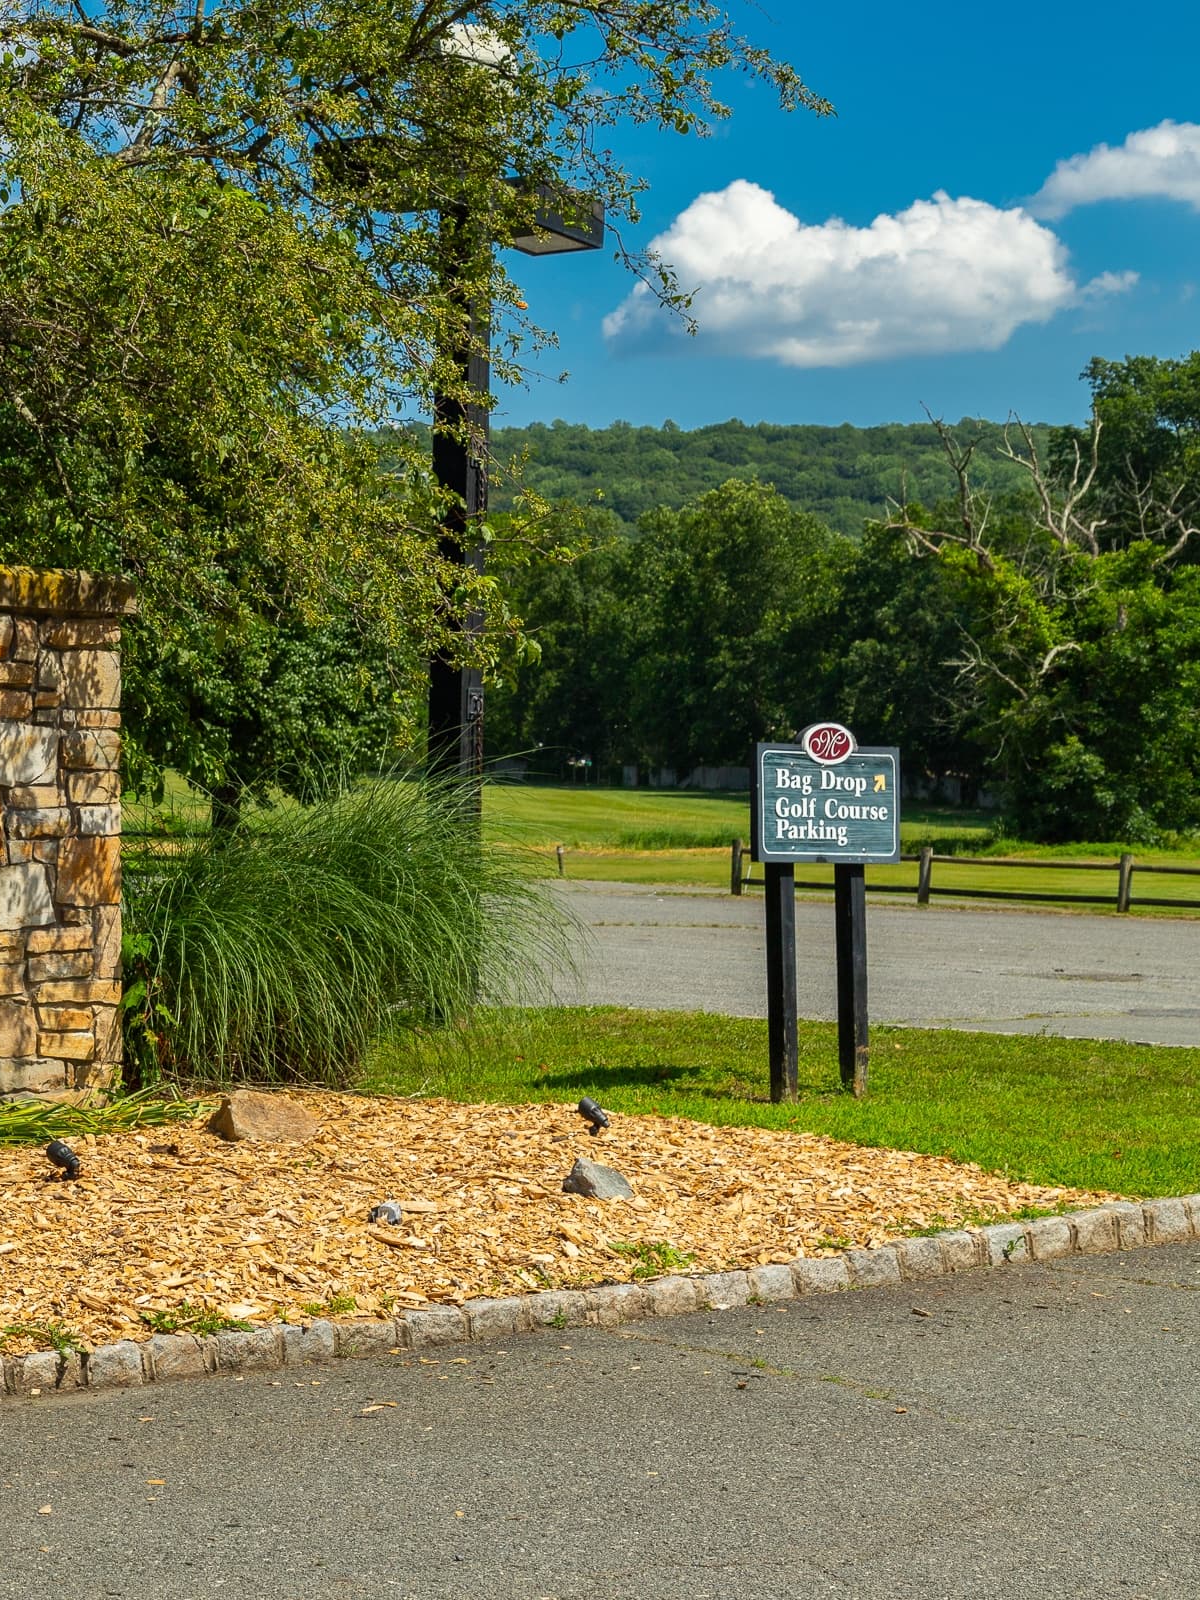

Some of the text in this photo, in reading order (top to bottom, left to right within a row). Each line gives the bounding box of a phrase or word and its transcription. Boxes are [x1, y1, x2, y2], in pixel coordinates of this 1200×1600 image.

[775, 768, 867, 797] Bag Drop
[775, 797, 888, 820] Golf Course
[775, 819, 848, 846] Parking
